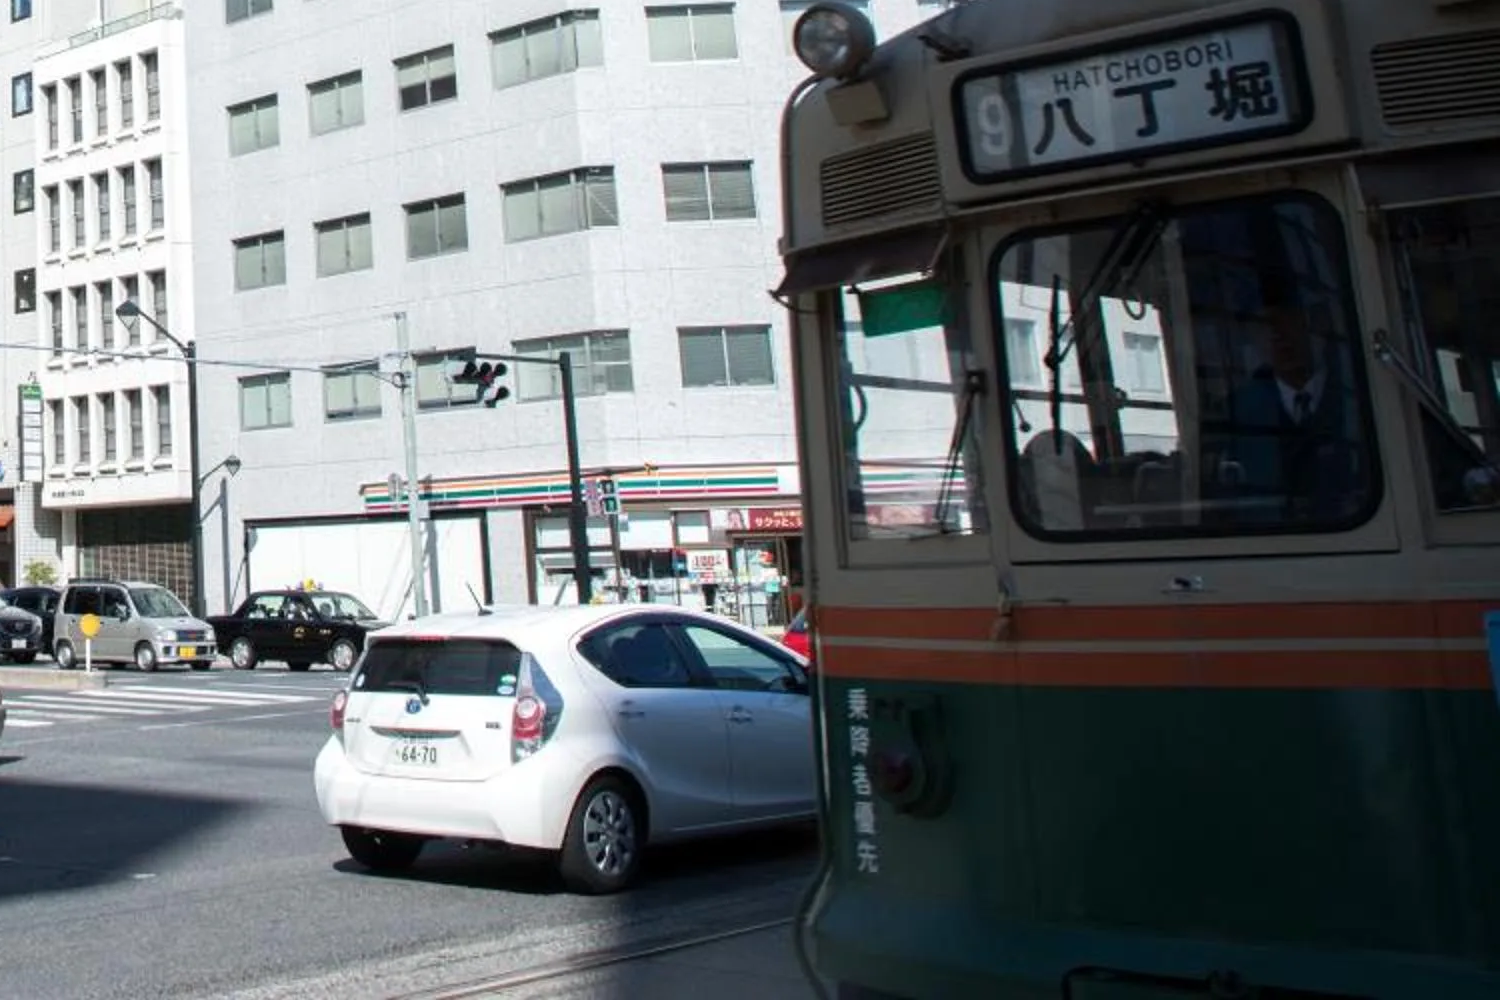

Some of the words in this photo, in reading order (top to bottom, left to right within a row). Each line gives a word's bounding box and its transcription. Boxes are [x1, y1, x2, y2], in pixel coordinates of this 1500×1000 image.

[1052, 38, 1234, 92] HATCHOBORI
[978, 93, 1012, 157] 9
[1032, 60, 1280, 156] 八丁堀
[401, 746, 438, 764] 64-70
